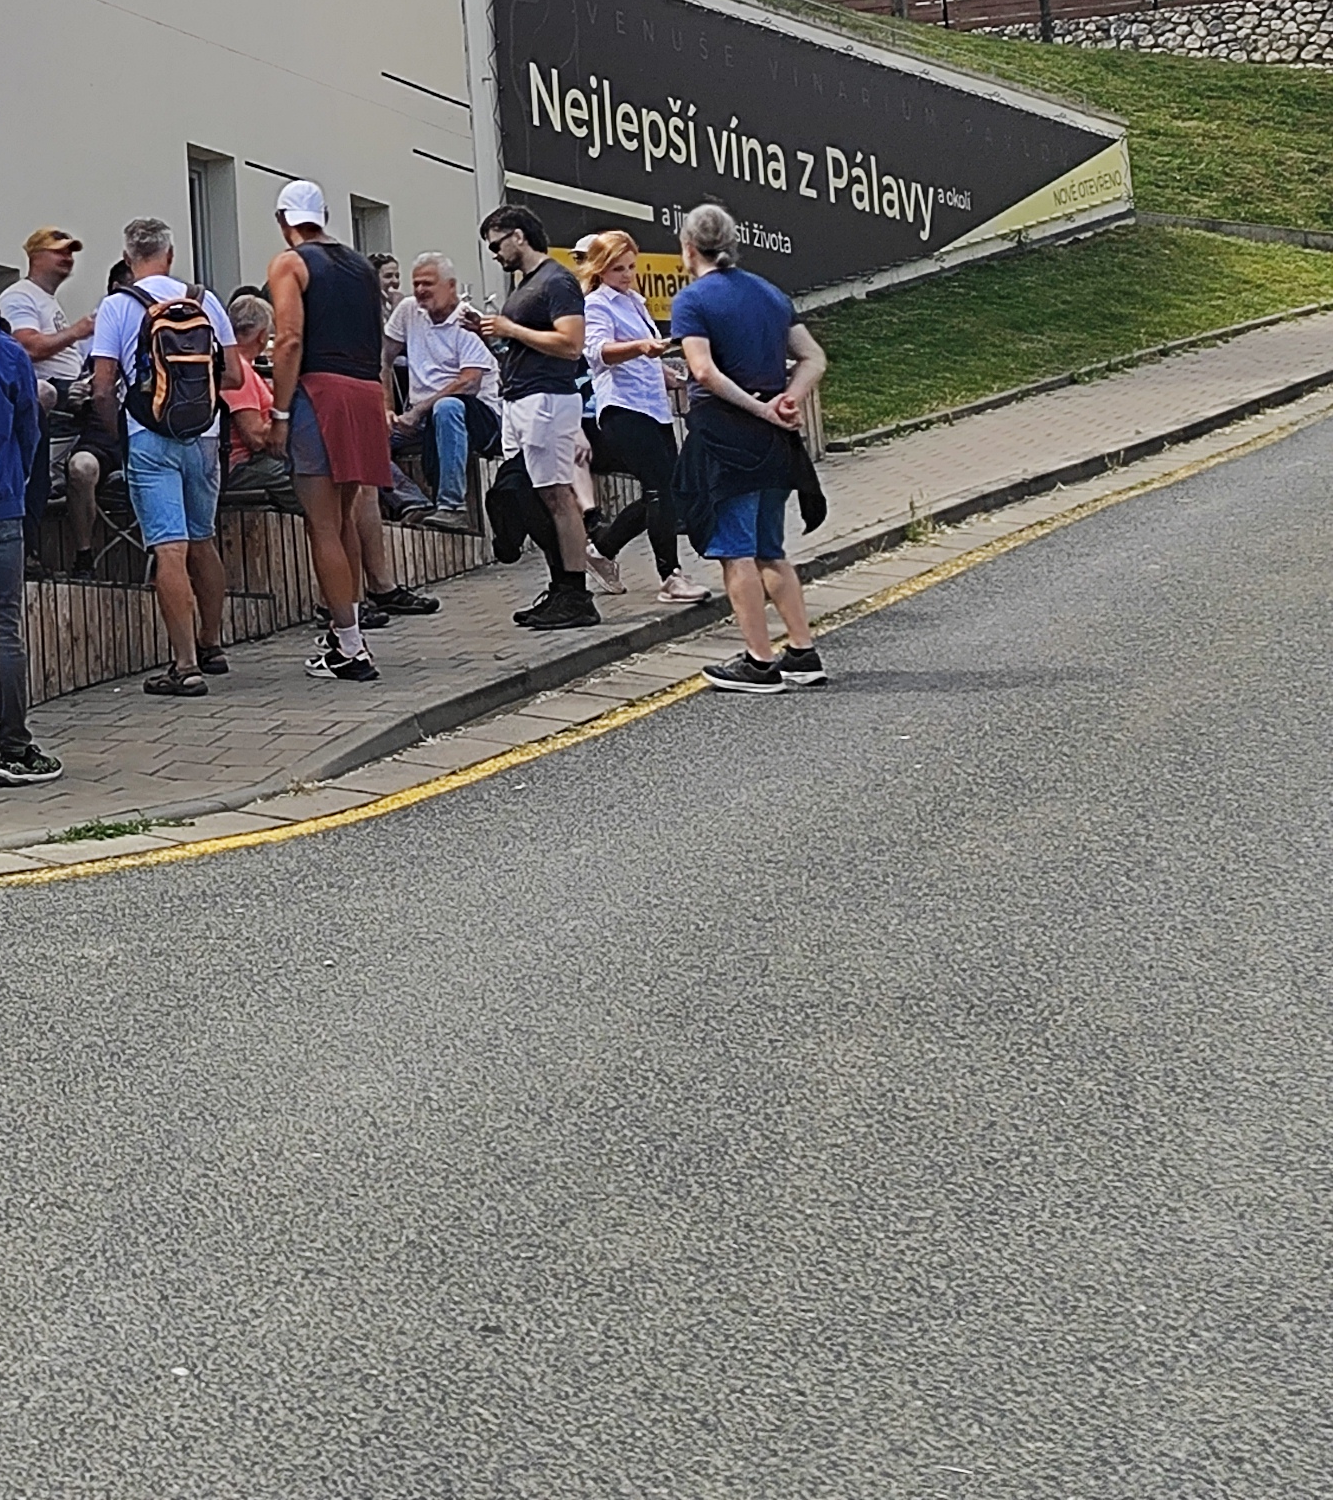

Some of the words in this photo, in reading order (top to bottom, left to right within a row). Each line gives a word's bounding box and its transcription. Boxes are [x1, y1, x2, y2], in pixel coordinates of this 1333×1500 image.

[529, 62, 697, 171] Nejlepší
[707, 116, 786, 190] vína
[797, 151, 817, 198] z
[826, 146, 933, 241] Pálavy
[938, 188, 945, 203] a
[946, 187, 971, 211] okolí
[661, 207, 670, 226] a
[753, 225, 792, 254] života
